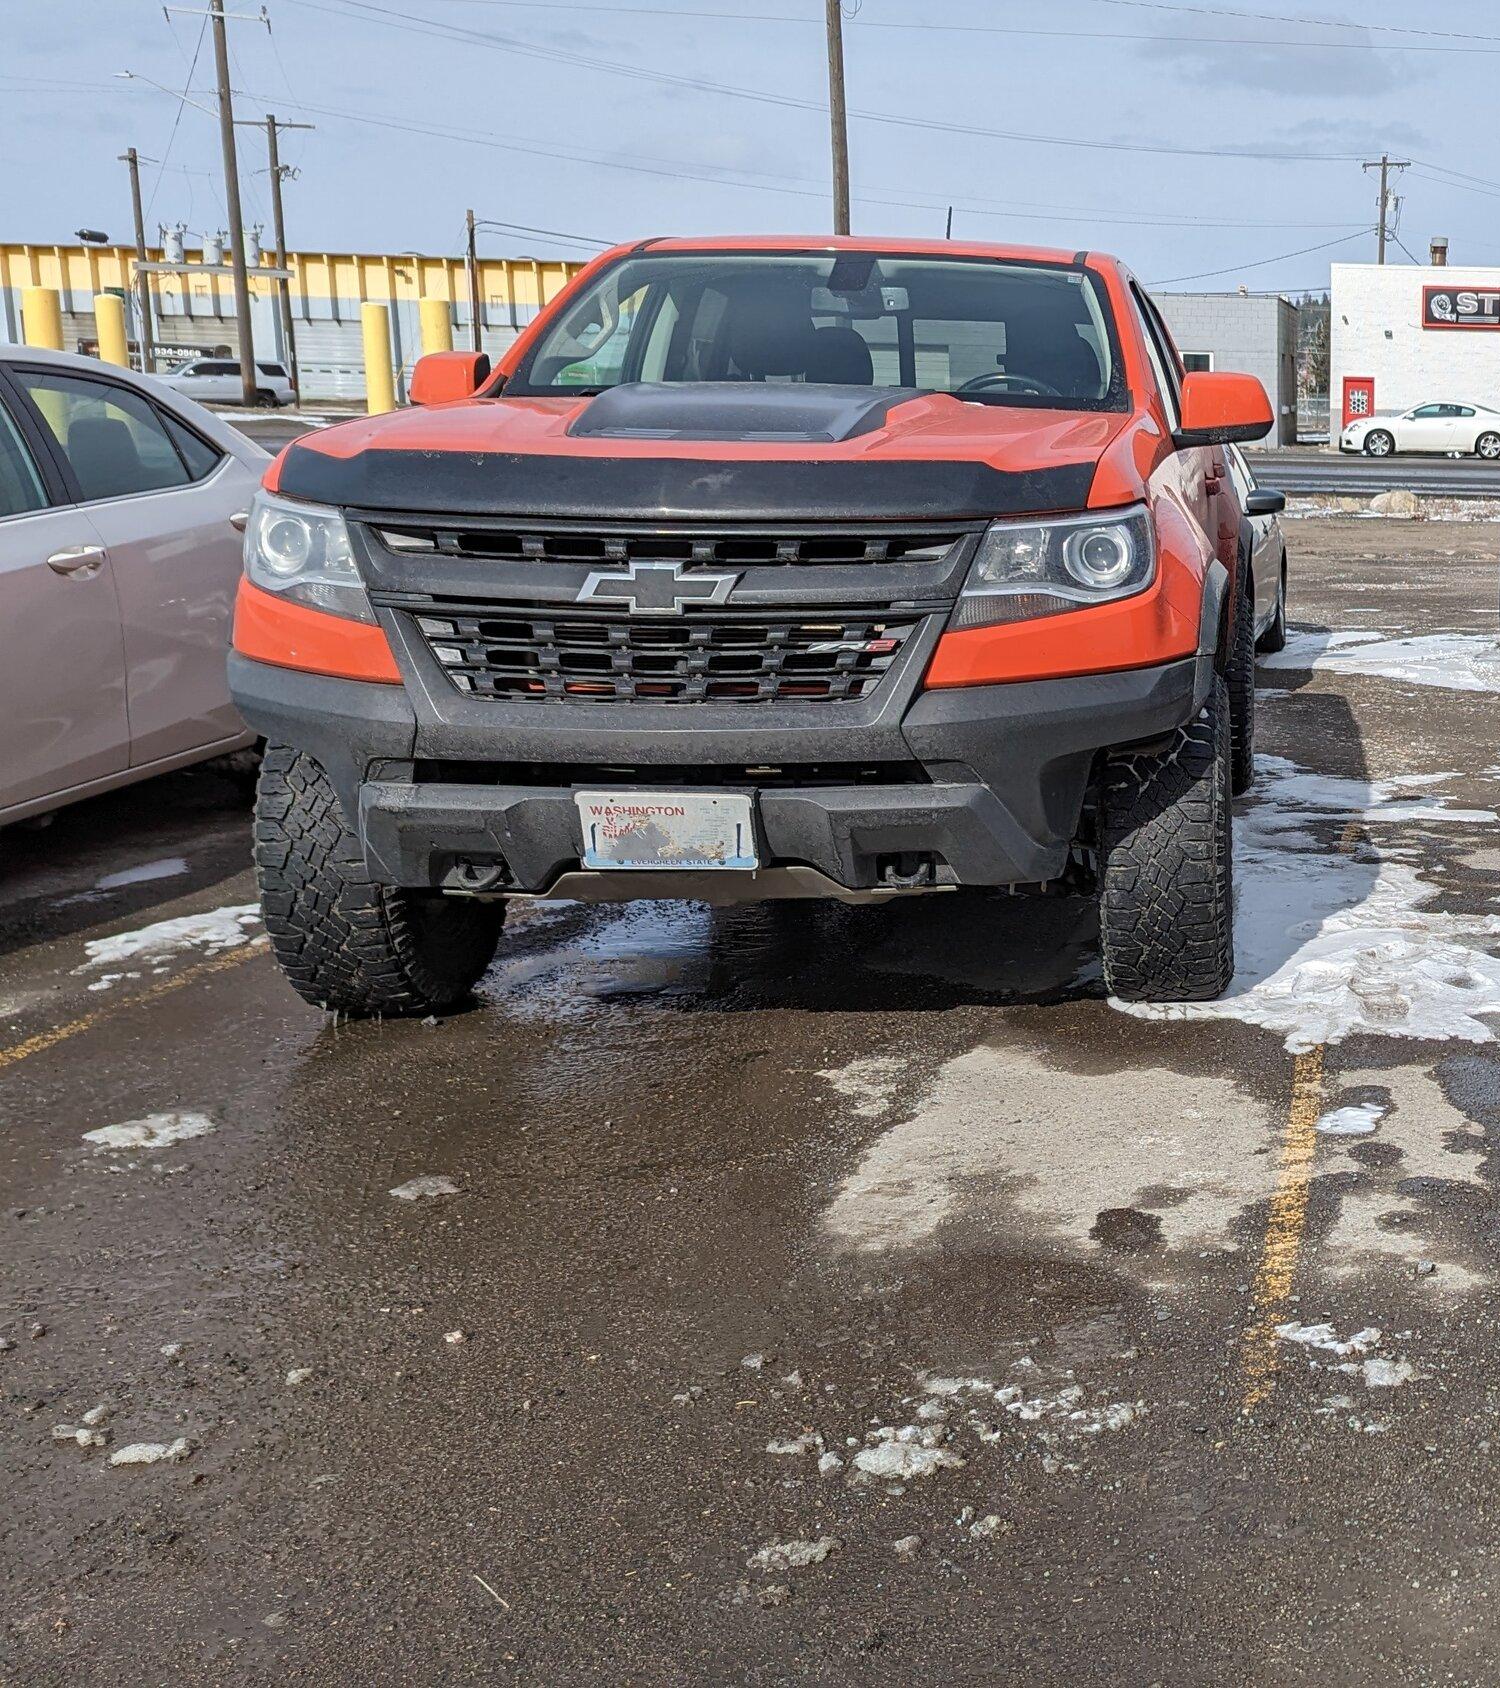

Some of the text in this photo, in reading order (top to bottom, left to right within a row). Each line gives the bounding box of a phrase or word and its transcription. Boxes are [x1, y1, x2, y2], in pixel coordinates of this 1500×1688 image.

[589, 805, 686, 817] WASHINGTON
[630, 859, 714, 867] EVERGREEN STATE
